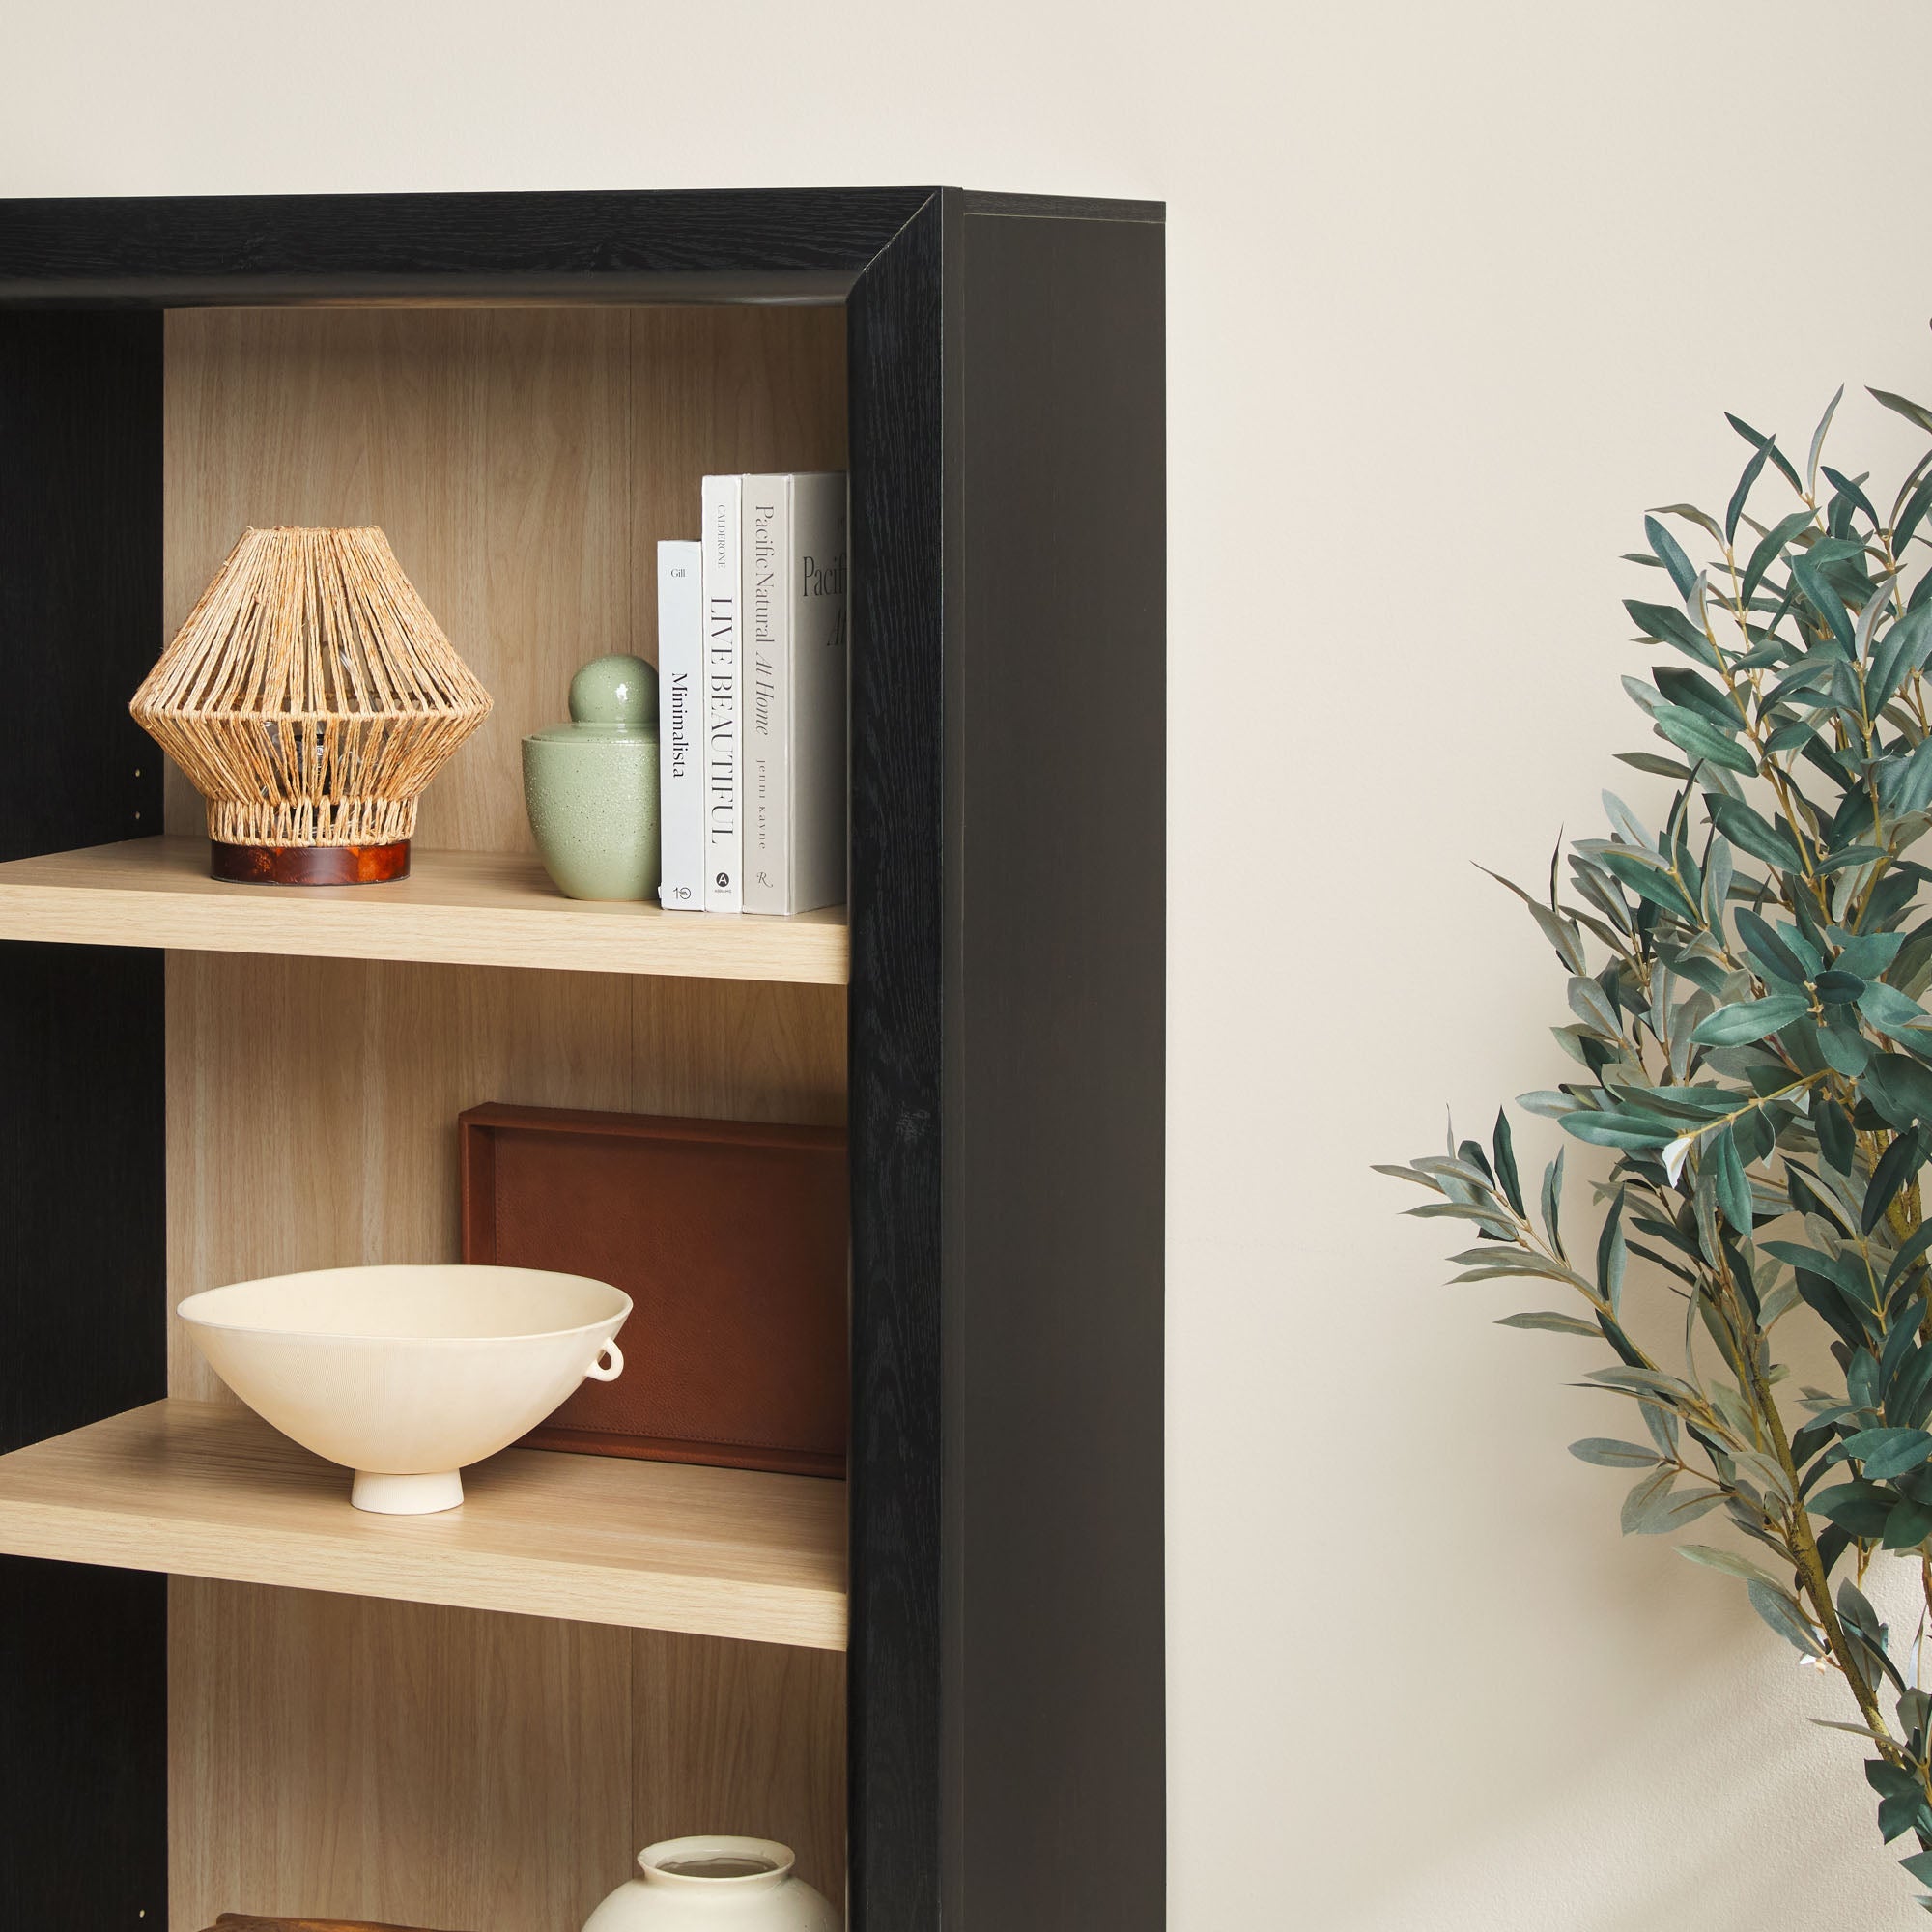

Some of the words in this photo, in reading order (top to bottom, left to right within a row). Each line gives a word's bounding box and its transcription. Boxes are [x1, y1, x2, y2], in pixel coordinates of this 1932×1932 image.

[717, 504, 726, 569] CALDERONE
[755, 505, 775, 571] Pacific
[670, 568, 686, 579] Gill
[803, 552, 847, 597] Pacif
[711, 596, 733, 665] LIVE
[755, 573, 775, 643] Natural
[755, 652, 774, 675] At
[671, 672, 689, 779] Minimalista
[755, 680, 774, 736] Home
[711, 674, 734, 844] BEAUTIFUL
